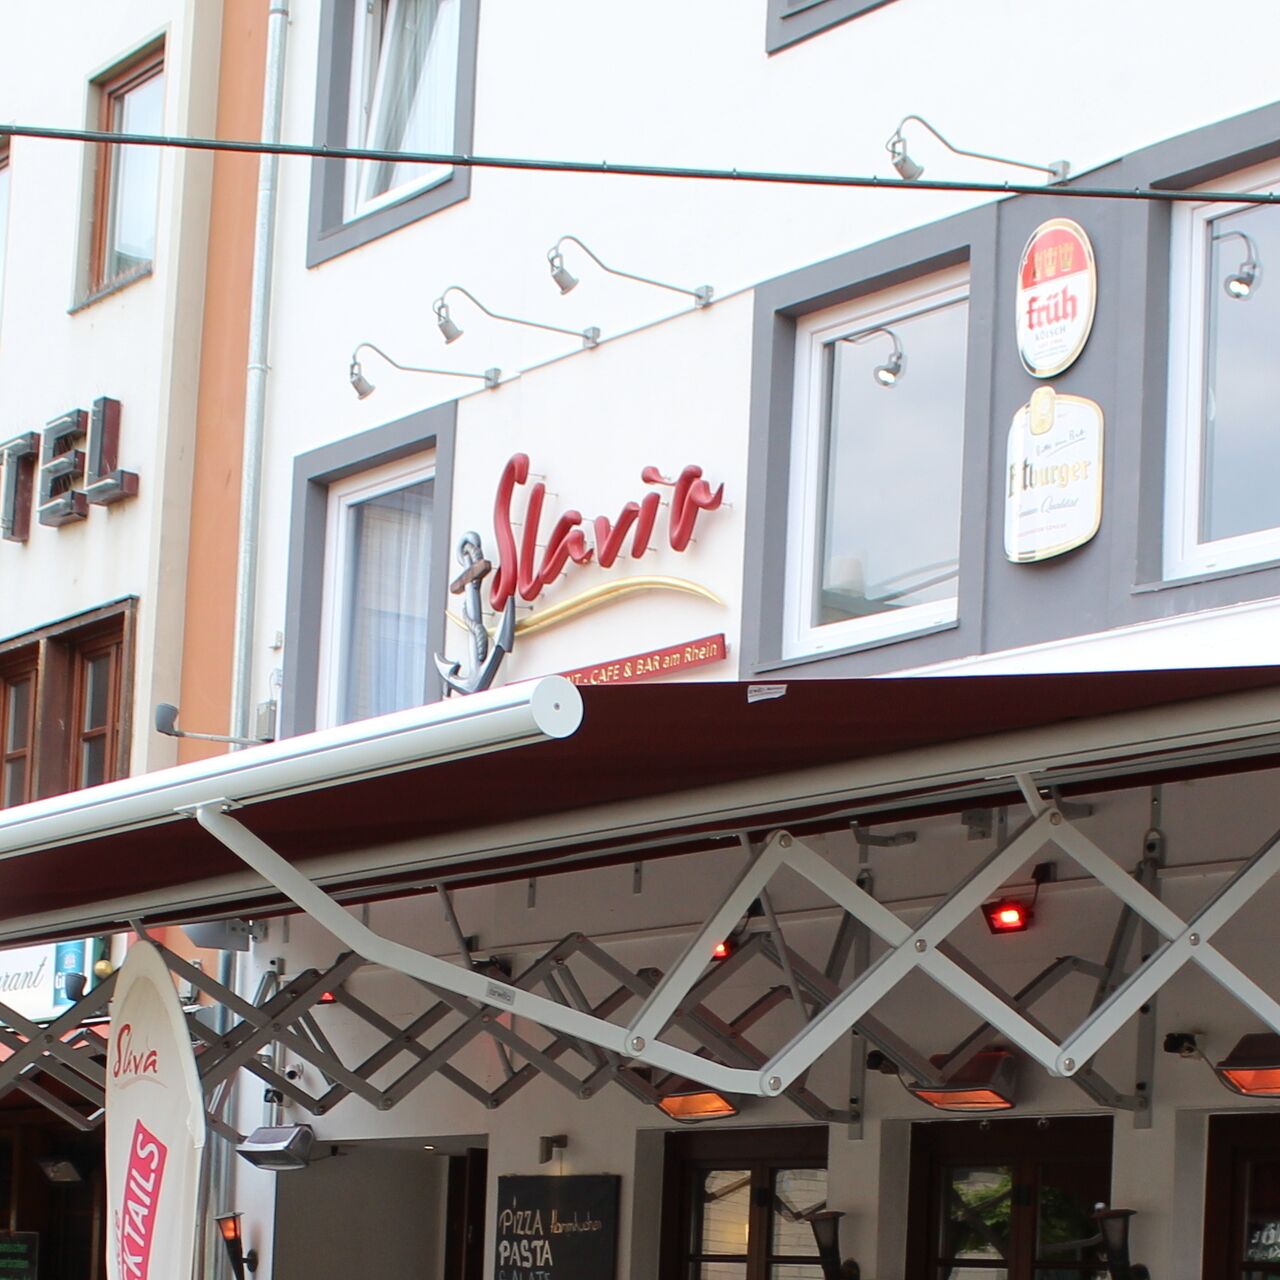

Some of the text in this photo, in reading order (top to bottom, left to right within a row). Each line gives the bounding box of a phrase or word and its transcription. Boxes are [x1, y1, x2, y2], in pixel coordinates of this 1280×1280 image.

[1026, 284, 1078, 331] früh
[590, 664, 620, 685] CAFE
[623, 663, 632, 678] &
[636, 655, 660, 675] BAR
[663, 653, 681, 669] am
[684, 641, 718, 663] Rhein
[499, 1240, 553, 1268] PASTA
